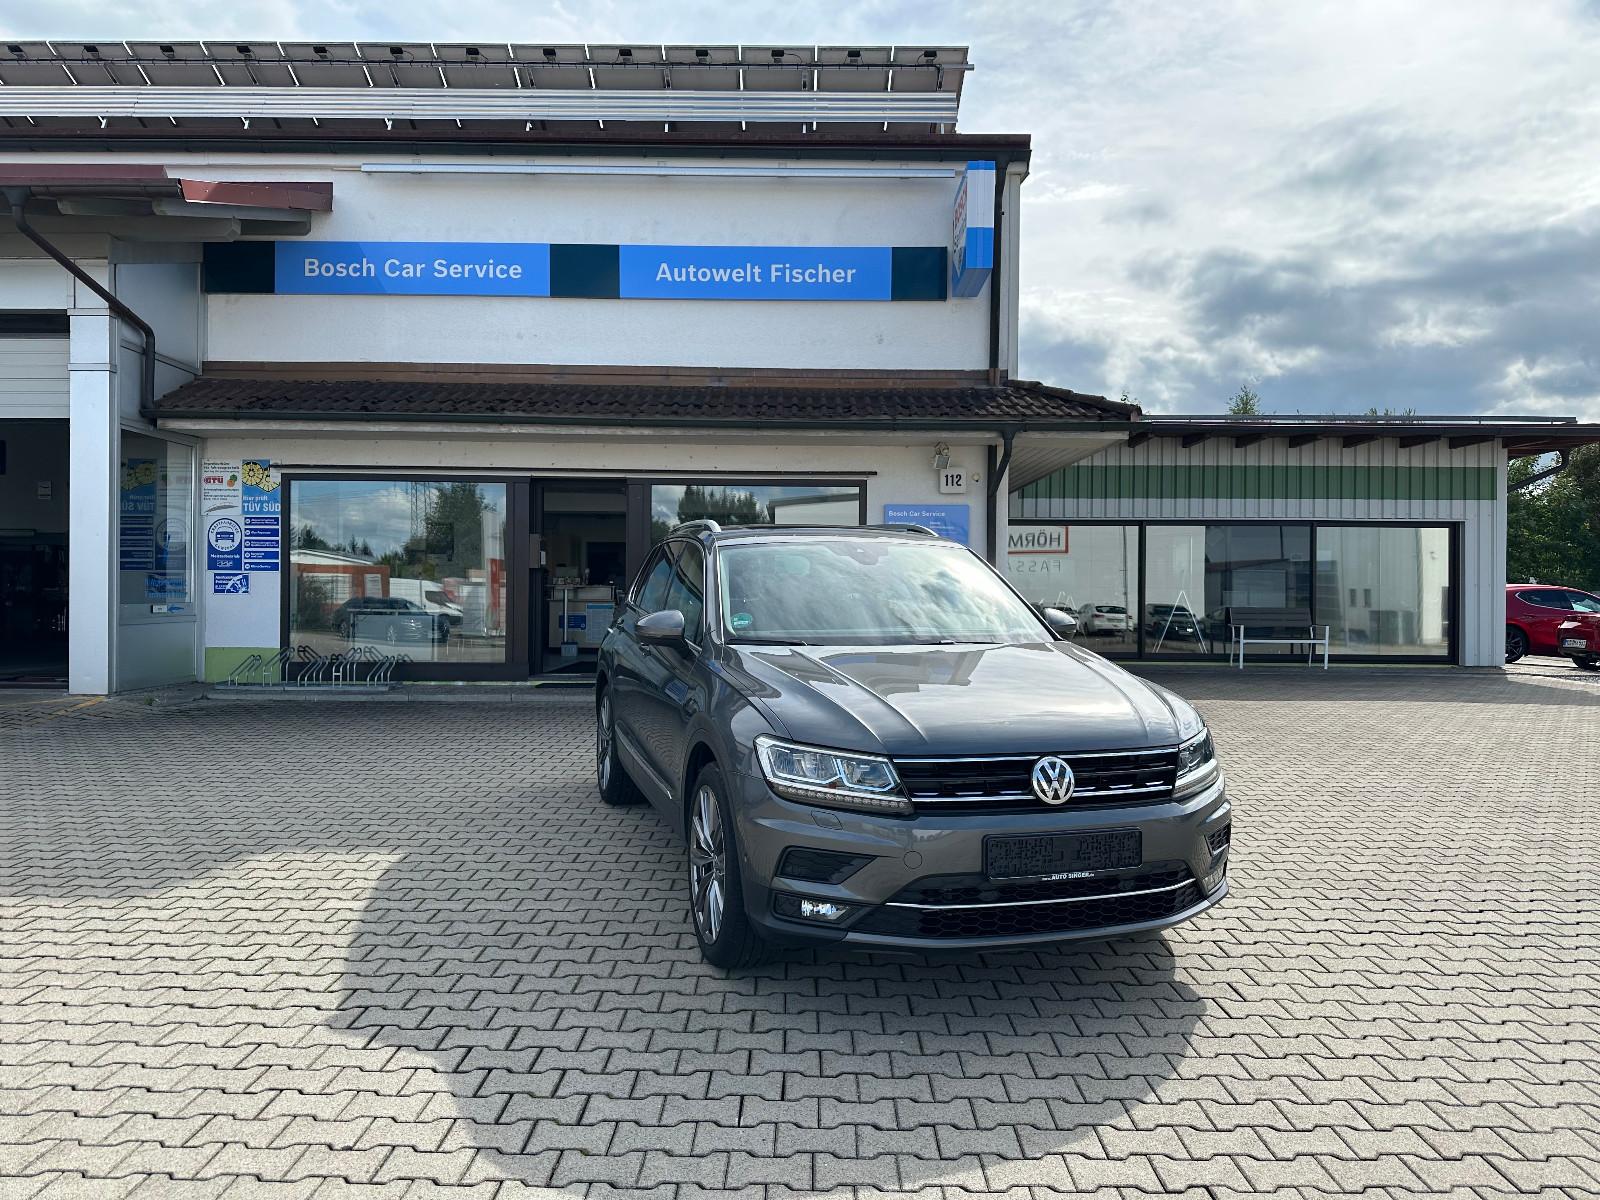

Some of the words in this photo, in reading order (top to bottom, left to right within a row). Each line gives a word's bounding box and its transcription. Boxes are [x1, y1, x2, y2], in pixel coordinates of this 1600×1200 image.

[304, 257, 376, 278] Bosch
[384, 258, 426, 278] Car
[433, 258, 523, 280] Service
[655, 262, 763, 283] Autowelt
[770, 263, 857, 283] Fischer
[204, 475, 224, 484] GTÜ
[944, 473, 962, 487] 112
[243, 501, 261, 512] TÜV
[262, 501, 281, 512] SÜD
